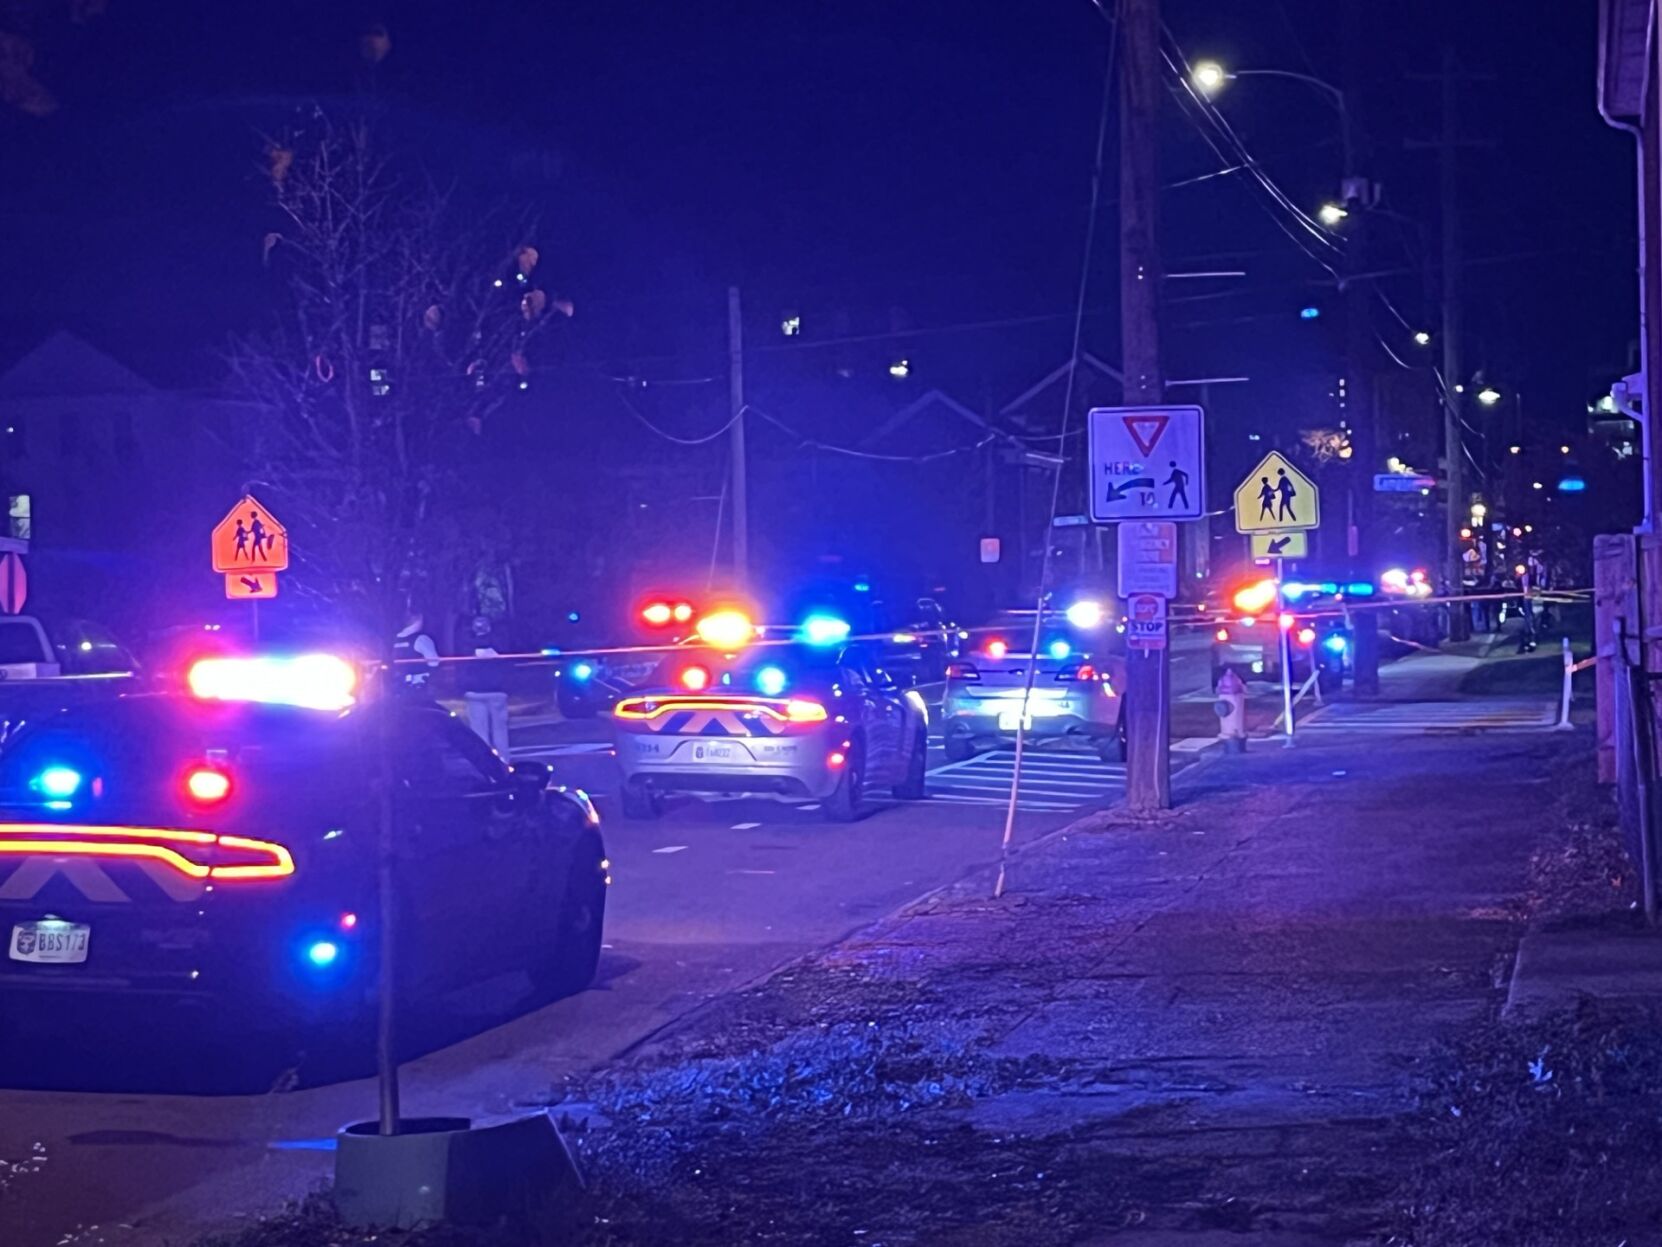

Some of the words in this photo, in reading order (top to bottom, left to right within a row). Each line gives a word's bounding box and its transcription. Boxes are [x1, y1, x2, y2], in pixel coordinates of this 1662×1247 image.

[1104, 461, 1141, 475] HERE
[1140, 492, 1155, 506] TO
[1131, 622, 1163, 632] STOP
[39, 933, 85, 951] BBS173
